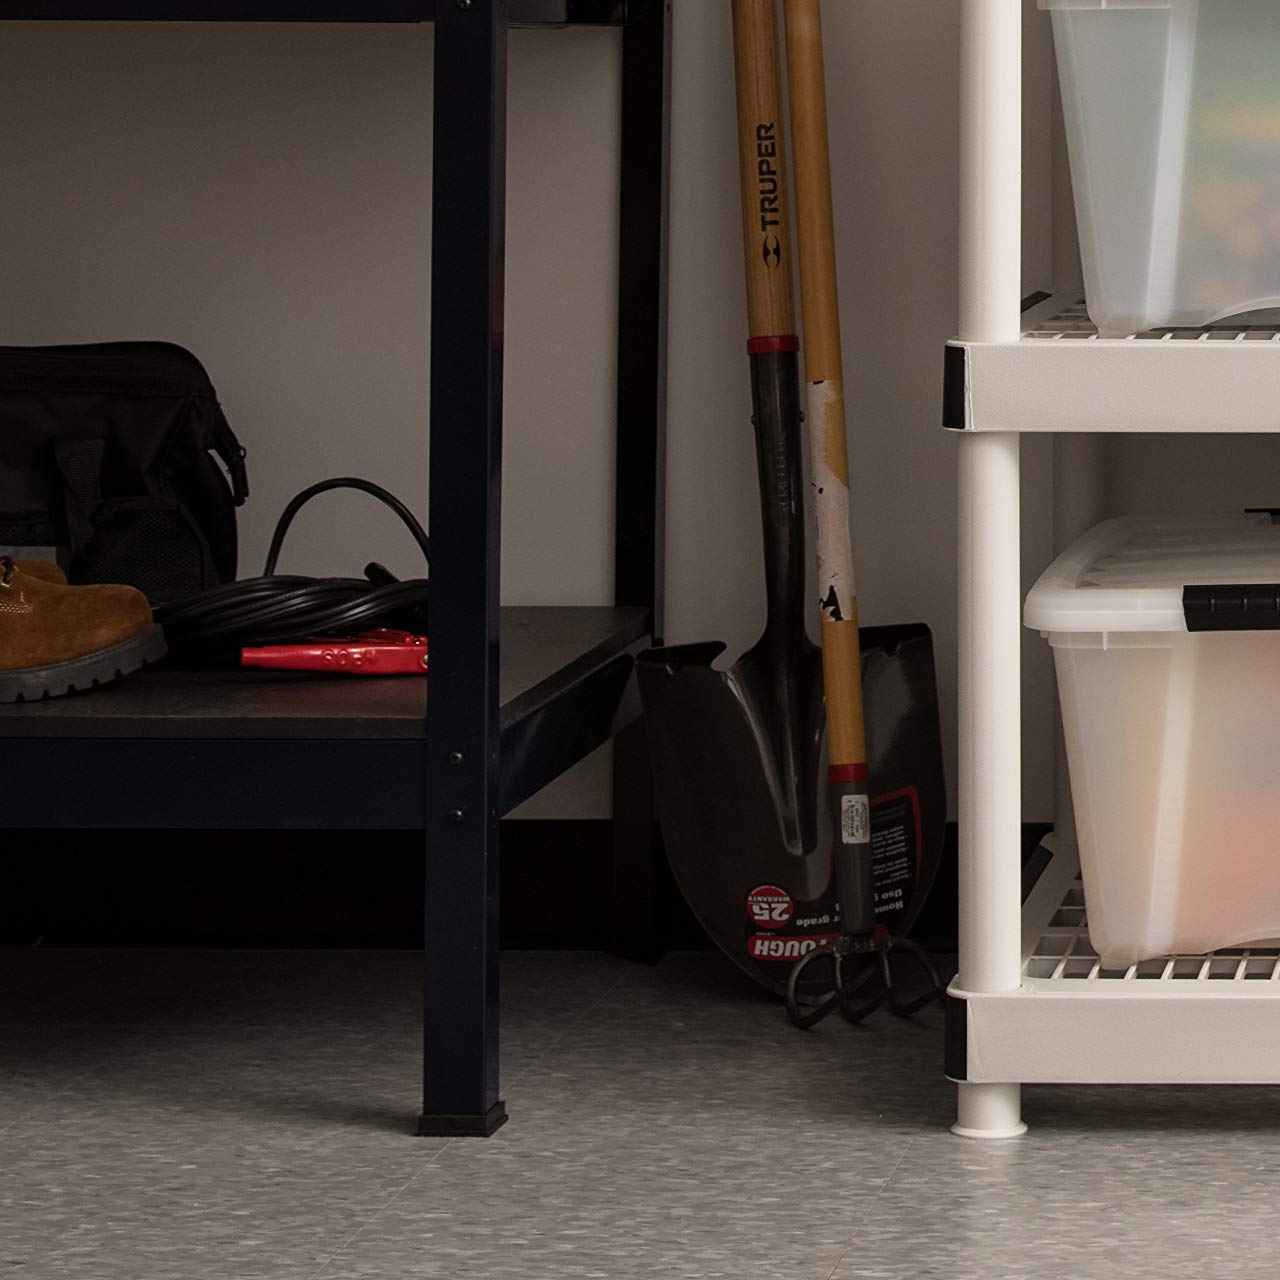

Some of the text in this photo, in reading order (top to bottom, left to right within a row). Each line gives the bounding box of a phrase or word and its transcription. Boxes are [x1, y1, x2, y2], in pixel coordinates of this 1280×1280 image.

[756, 122, 779, 232] TRUPER
[752, 903, 789, 921] 25
[754, 938, 828, 957] OUGH
